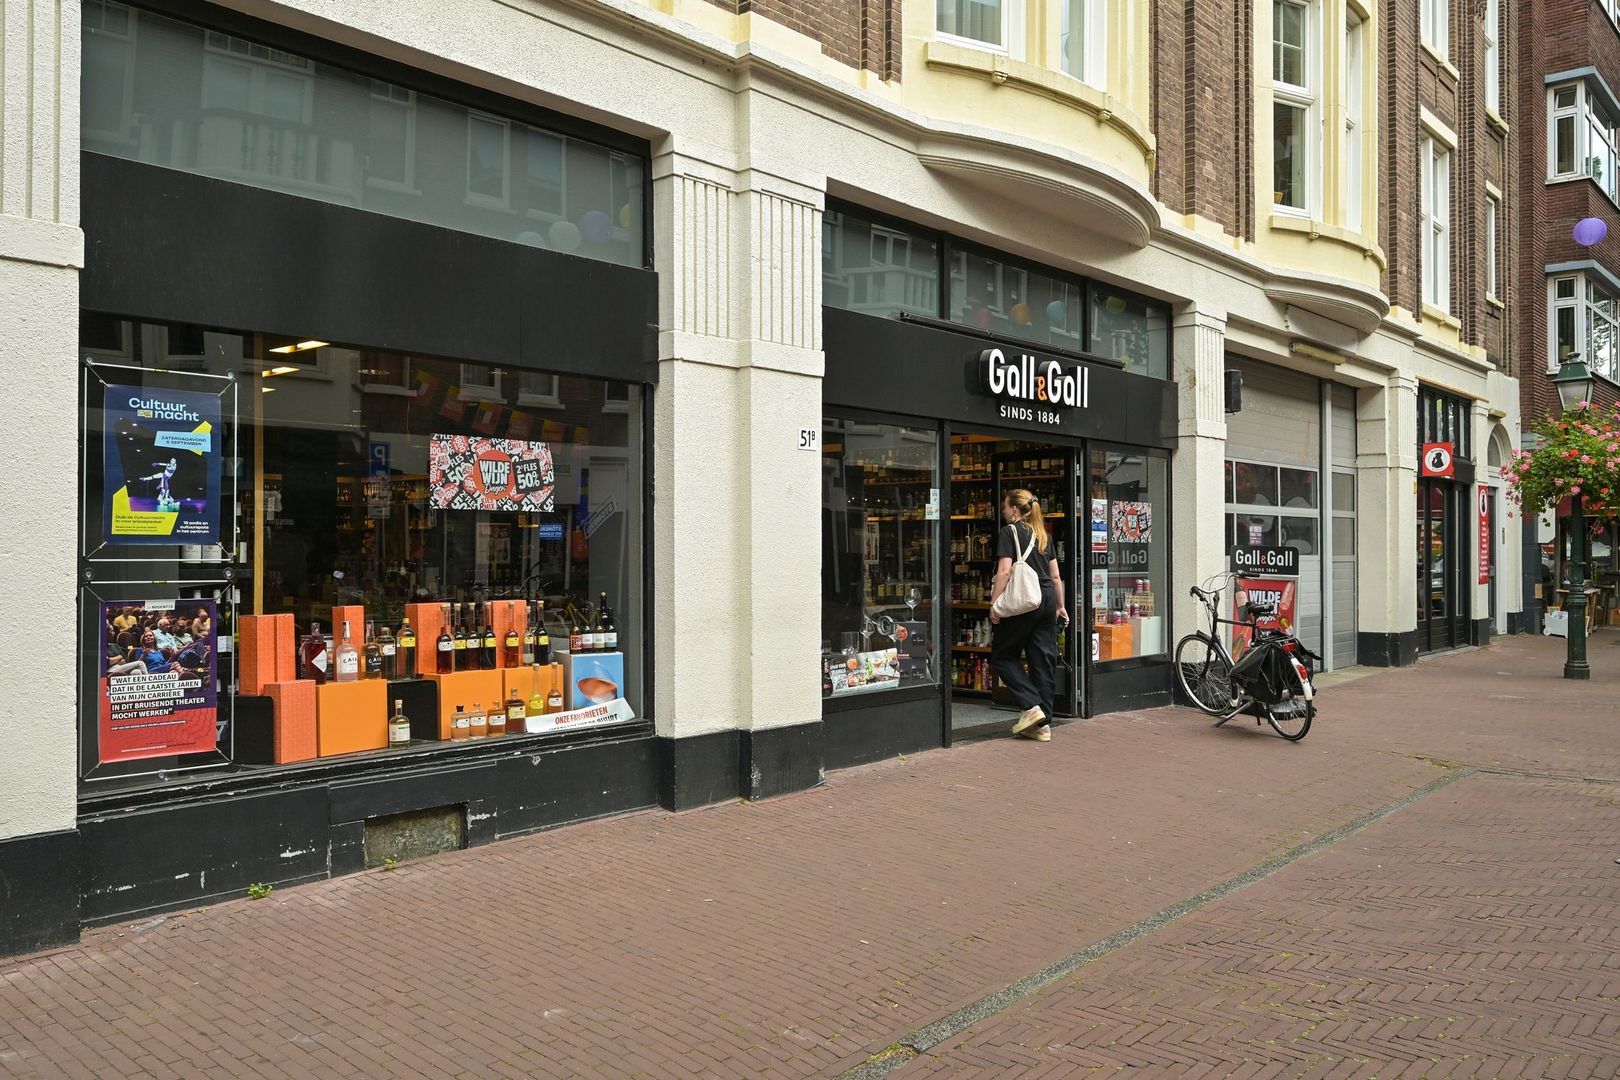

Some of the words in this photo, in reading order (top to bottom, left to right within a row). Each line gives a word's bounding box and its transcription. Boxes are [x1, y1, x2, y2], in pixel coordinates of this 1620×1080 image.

[128, 397, 187, 412] Cultuur
[154, 409, 200, 422] nacht
[1000, 405, 1033, 421] SINDS
[1037, 411, 1061, 425] 1884
[479, 460, 511, 474] WILDE
[523, 462, 538, 472] FLES
[482, 473, 508, 485] WIJN
[517, 471, 541, 490] 50%
[1248, 589, 1281, 605] WILDE
[147, 674, 177, 682] CADEAU
[146, 682, 176, 690] LAATSTE
[177, 680, 199, 688] JAREN
[128, 693, 146, 701] MIJN
[134, 700, 174, 709] BRUISENDE
[175, 697, 205, 705] THEATER
[112, 712, 137, 720] MOCHT
[555, 715, 570, 725] ONZE
[570, 706, 609, 722] FAVORIETEN
